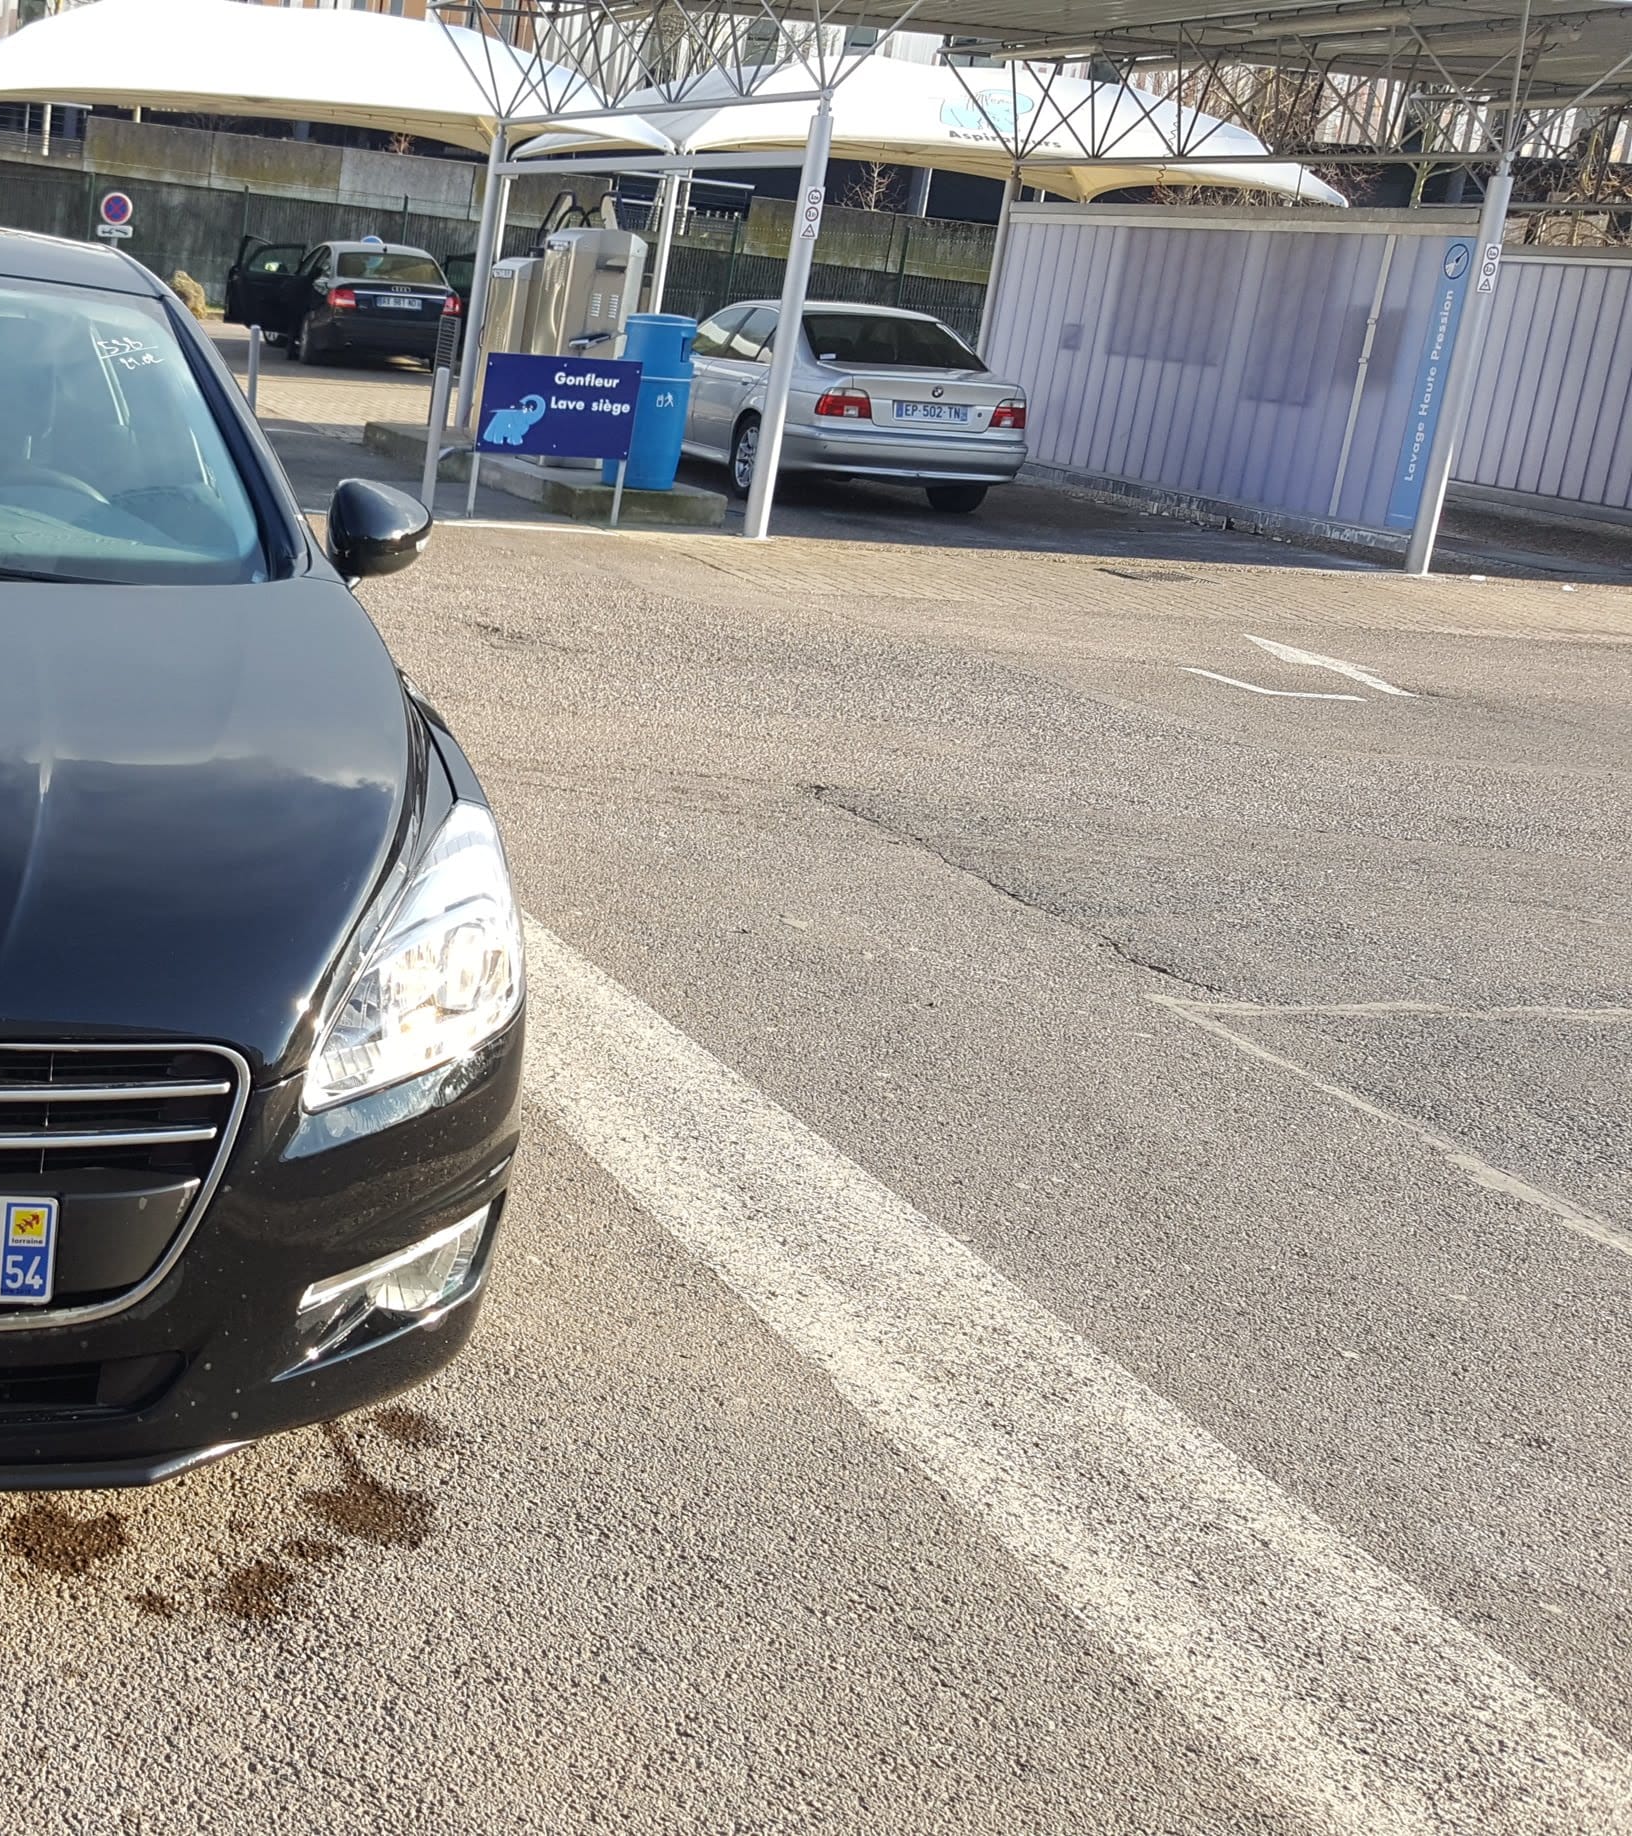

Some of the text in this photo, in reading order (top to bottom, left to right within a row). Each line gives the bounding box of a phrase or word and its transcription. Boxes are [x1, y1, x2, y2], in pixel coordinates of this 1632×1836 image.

[554, 371, 620, 388] Gonfleur
[1404, 290, 1454, 481] Lavage Haute Pression
[550, 396, 630, 416] Lave siège
[11, 1237, 44, 1245] lorraine
[5, 1254, 44, 1290] 54
